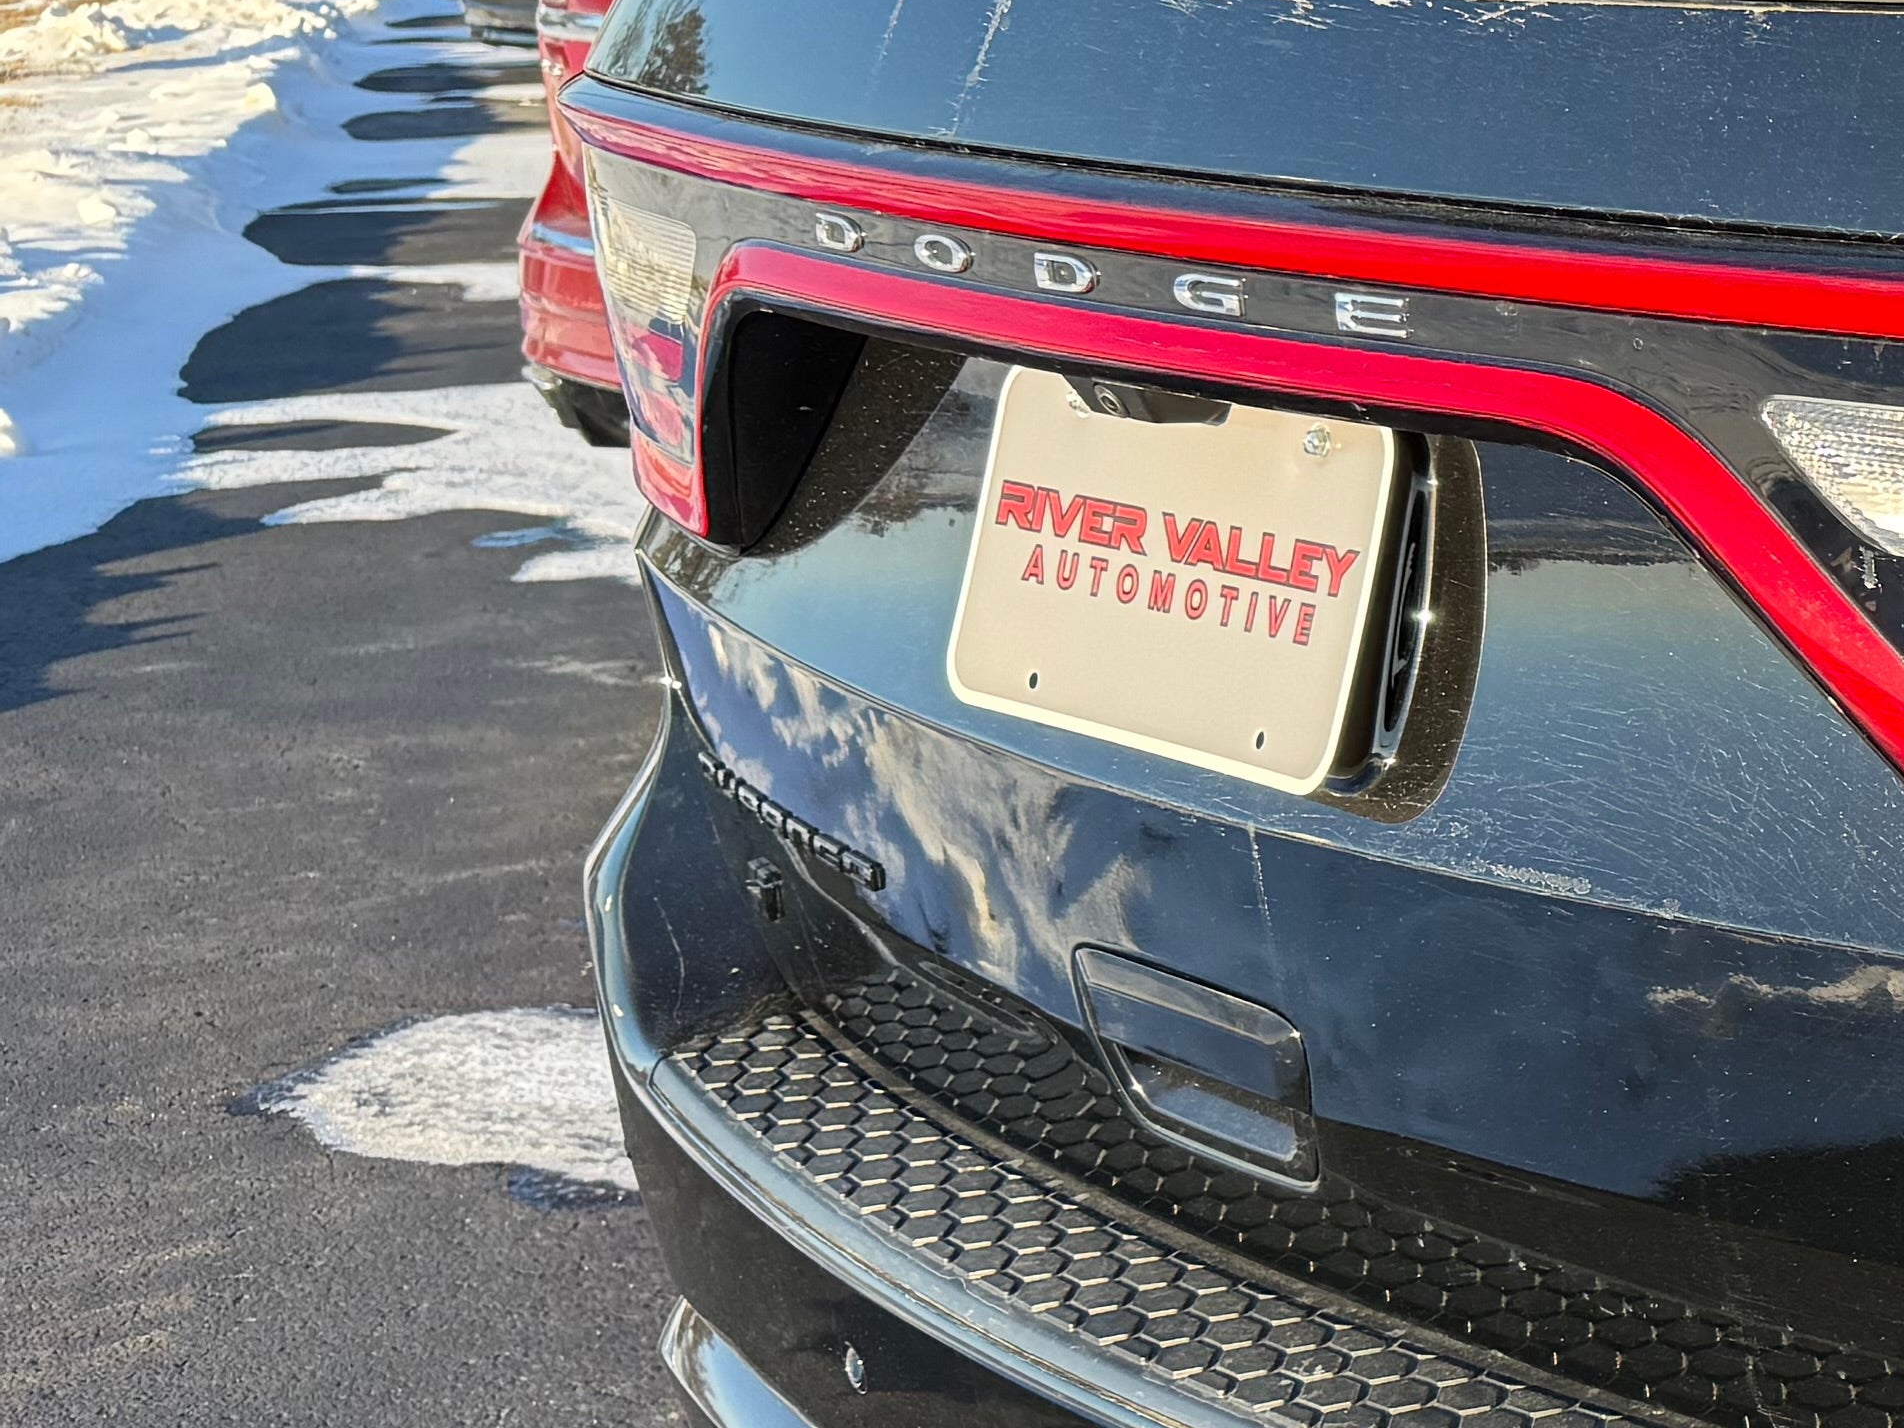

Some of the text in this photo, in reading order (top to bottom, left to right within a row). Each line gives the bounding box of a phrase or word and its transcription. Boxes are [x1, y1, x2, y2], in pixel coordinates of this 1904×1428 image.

[813, 211, 1413, 339] DODGE
[994, 479, 1361, 599] RIVER VALLEY
[1021, 543, 1317, 647] AUTOMOTIVE
